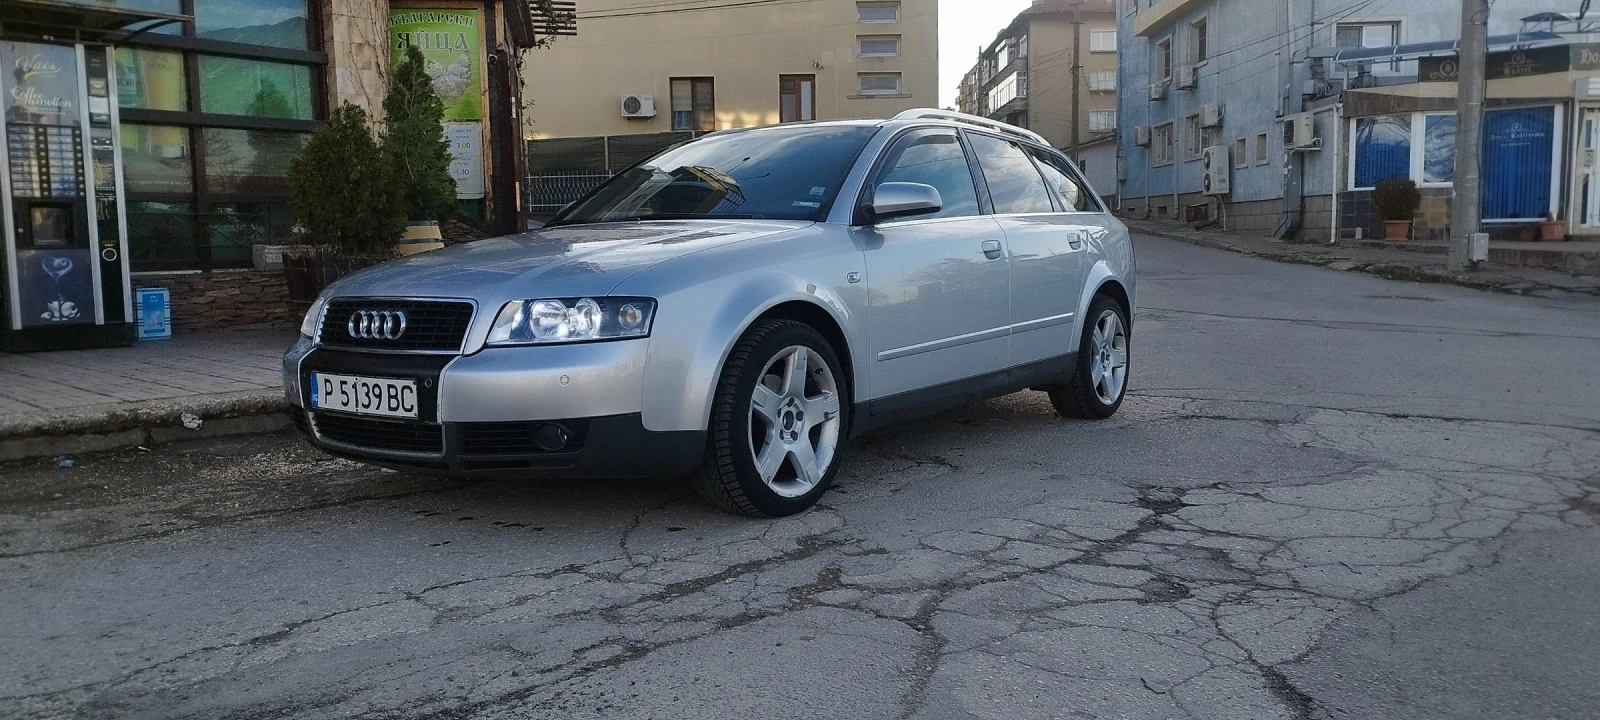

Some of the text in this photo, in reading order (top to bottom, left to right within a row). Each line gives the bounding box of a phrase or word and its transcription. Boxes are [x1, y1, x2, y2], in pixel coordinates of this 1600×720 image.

[390, 12, 474, 28] БЪЛГАРСКИ
[397, 28, 470, 54] ЯЙЦА
[11, 86, 44, 104] Coffee
[323, 378, 414, 412] P 5139 BC
